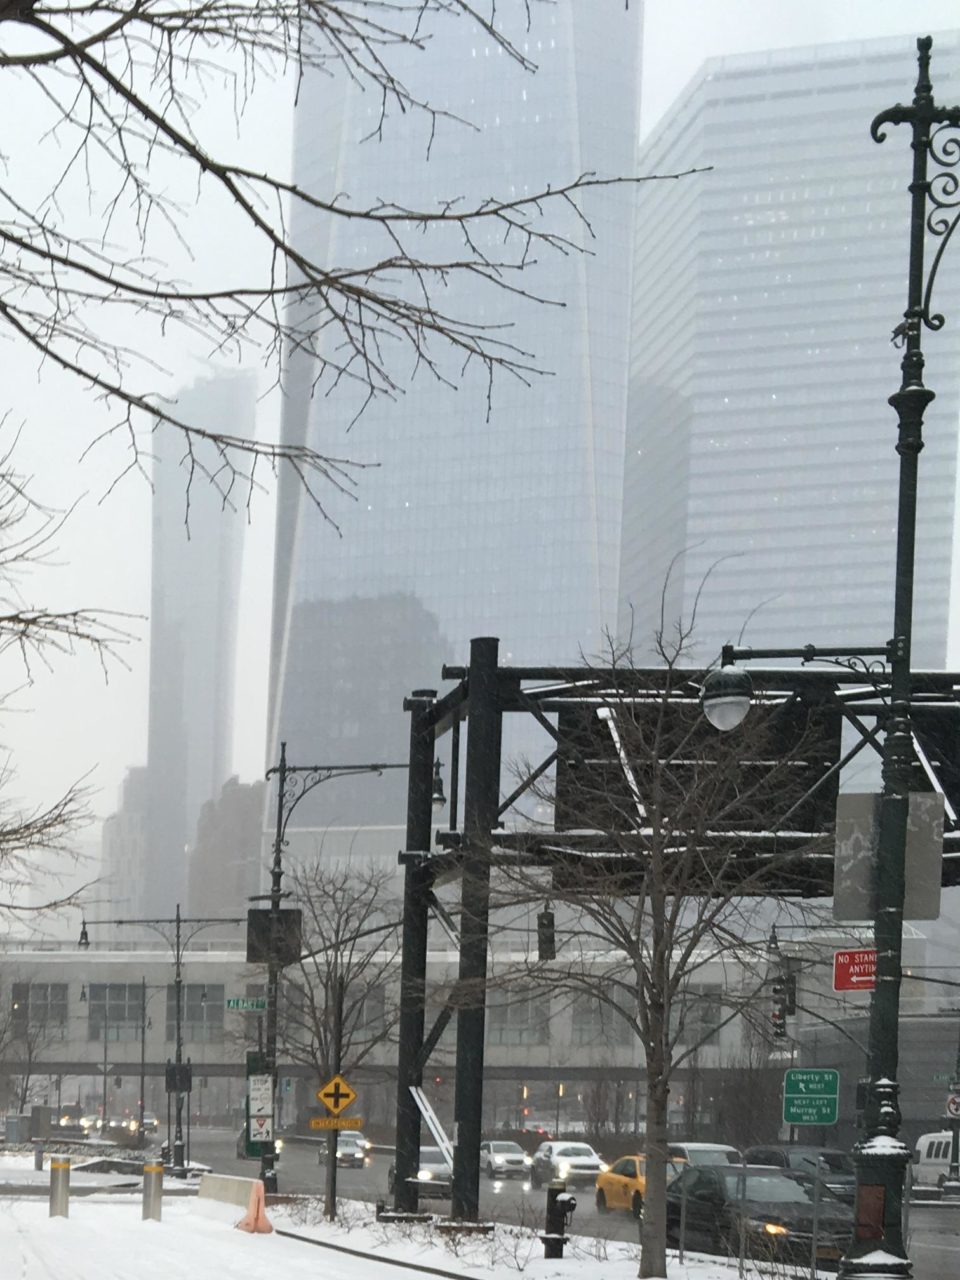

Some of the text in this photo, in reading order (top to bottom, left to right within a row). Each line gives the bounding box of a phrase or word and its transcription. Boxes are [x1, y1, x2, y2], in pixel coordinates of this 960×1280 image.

[838, 953, 878, 964] NO STAN
[791, 1073, 833, 1082] Liberty St
[790, 1106, 817, 1115] Murray
